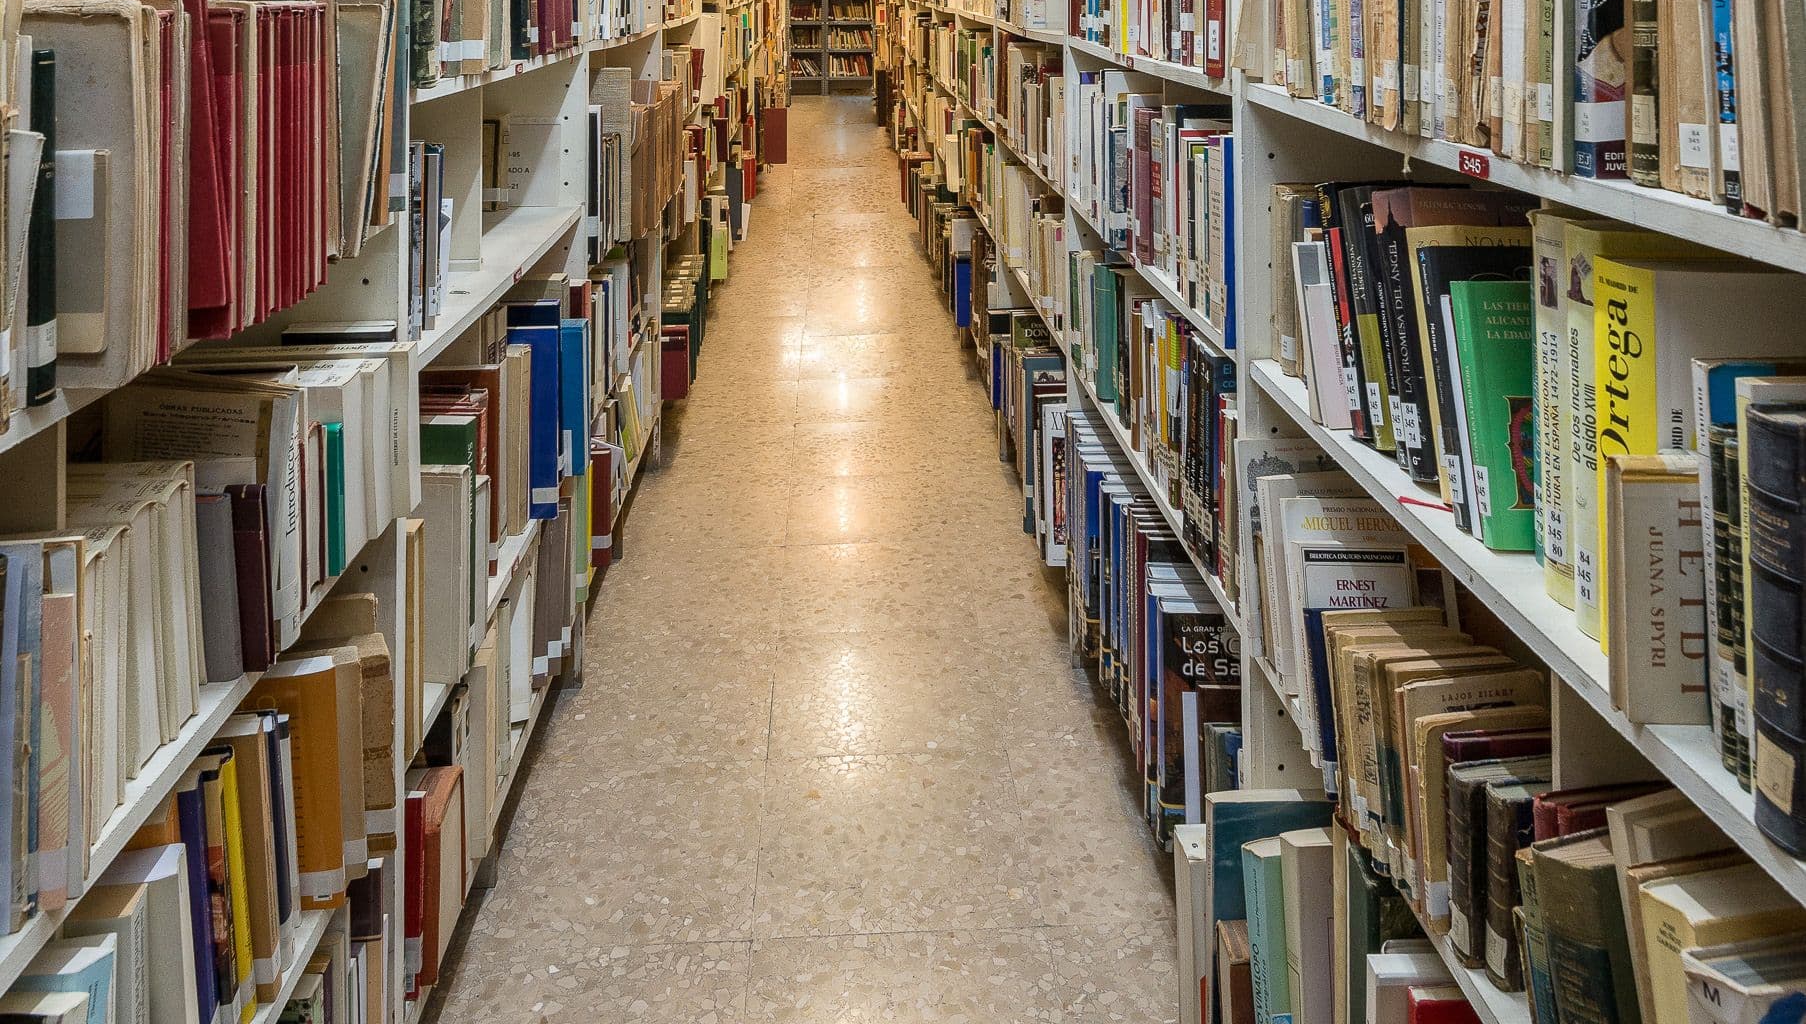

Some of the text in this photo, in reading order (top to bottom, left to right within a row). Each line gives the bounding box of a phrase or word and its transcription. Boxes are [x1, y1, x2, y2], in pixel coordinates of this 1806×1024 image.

[1581, 0, 1588, 10] EL
[1604, 152, 1625, 161] EDIT
[1463, 155, 1482, 173] 345
[1604, 162, 1627, 171] JUVE
[1318, 187, 1328, 227] ALFAGUARA
[1356, 255, 1364, 290] ESCENA
[1599, 276, 1638, 294] EL MADRID DE
[1377, 281, 1385, 309] BLANCO
[1483, 301, 1530, 312] LAS TIER
[1389, 240, 1413, 393] LA PROMESA DEL ÁNGEL
[1486, 316, 1531, 325] ALICANT
[1486, 330, 1531, 339] LA EDAD
[1541, 331, 1548, 345] LA
[1541, 349, 1548, 364] DE
[1191, 359, 1198, 374] 2
[1599, 298, 1642, 462] Ortega
[1569, 328, 1580, 464] De los incunables
[159, 404, 243, 415] OBRAS PUBLICADAS
[1405, 404, 1414, 415] 84
[1671, 408, 1683, 425] DE
[1404, 418, 1415, 428] 345
[1549, 334, 1561, 507] TURA EN ESPAÑA 1472-1914
[1582, 383, 1597, 471] al siglo XVIII
[1408, 433, 1417, 443] 74
[1543, 432, 1550, 446] LA
[1544, 449, 1551, 465] DE
[1476, 471, 1484, 481] 84
[1303, 516, 1353, 531] MIGUEL
[1550, 511, 1561, 524] 84
[1548, 526, 1562, 540] 345
[1552, 544, 1563, 558] 80
[1579, 552, 1590, 565] 84
[1703, 494, 1717, 638] CARLOS ARNICHES
[1577, 566, 1591, 583] 345
[1336, 579, 1376, 592] ERNEST
[1580, 586, 1591, 600] 81
[1649, 526, 1666, 668] JUANA SPYRI
[1329, 594, 1388, 608] MARTÍNEZ
[1193, 625, 1215, 633] GRAN
[1182, 636, 1219, 654] Los
[1182, 658, 1240, 676] de Sa
[1441, 692, 1473, 702] LAJOS
